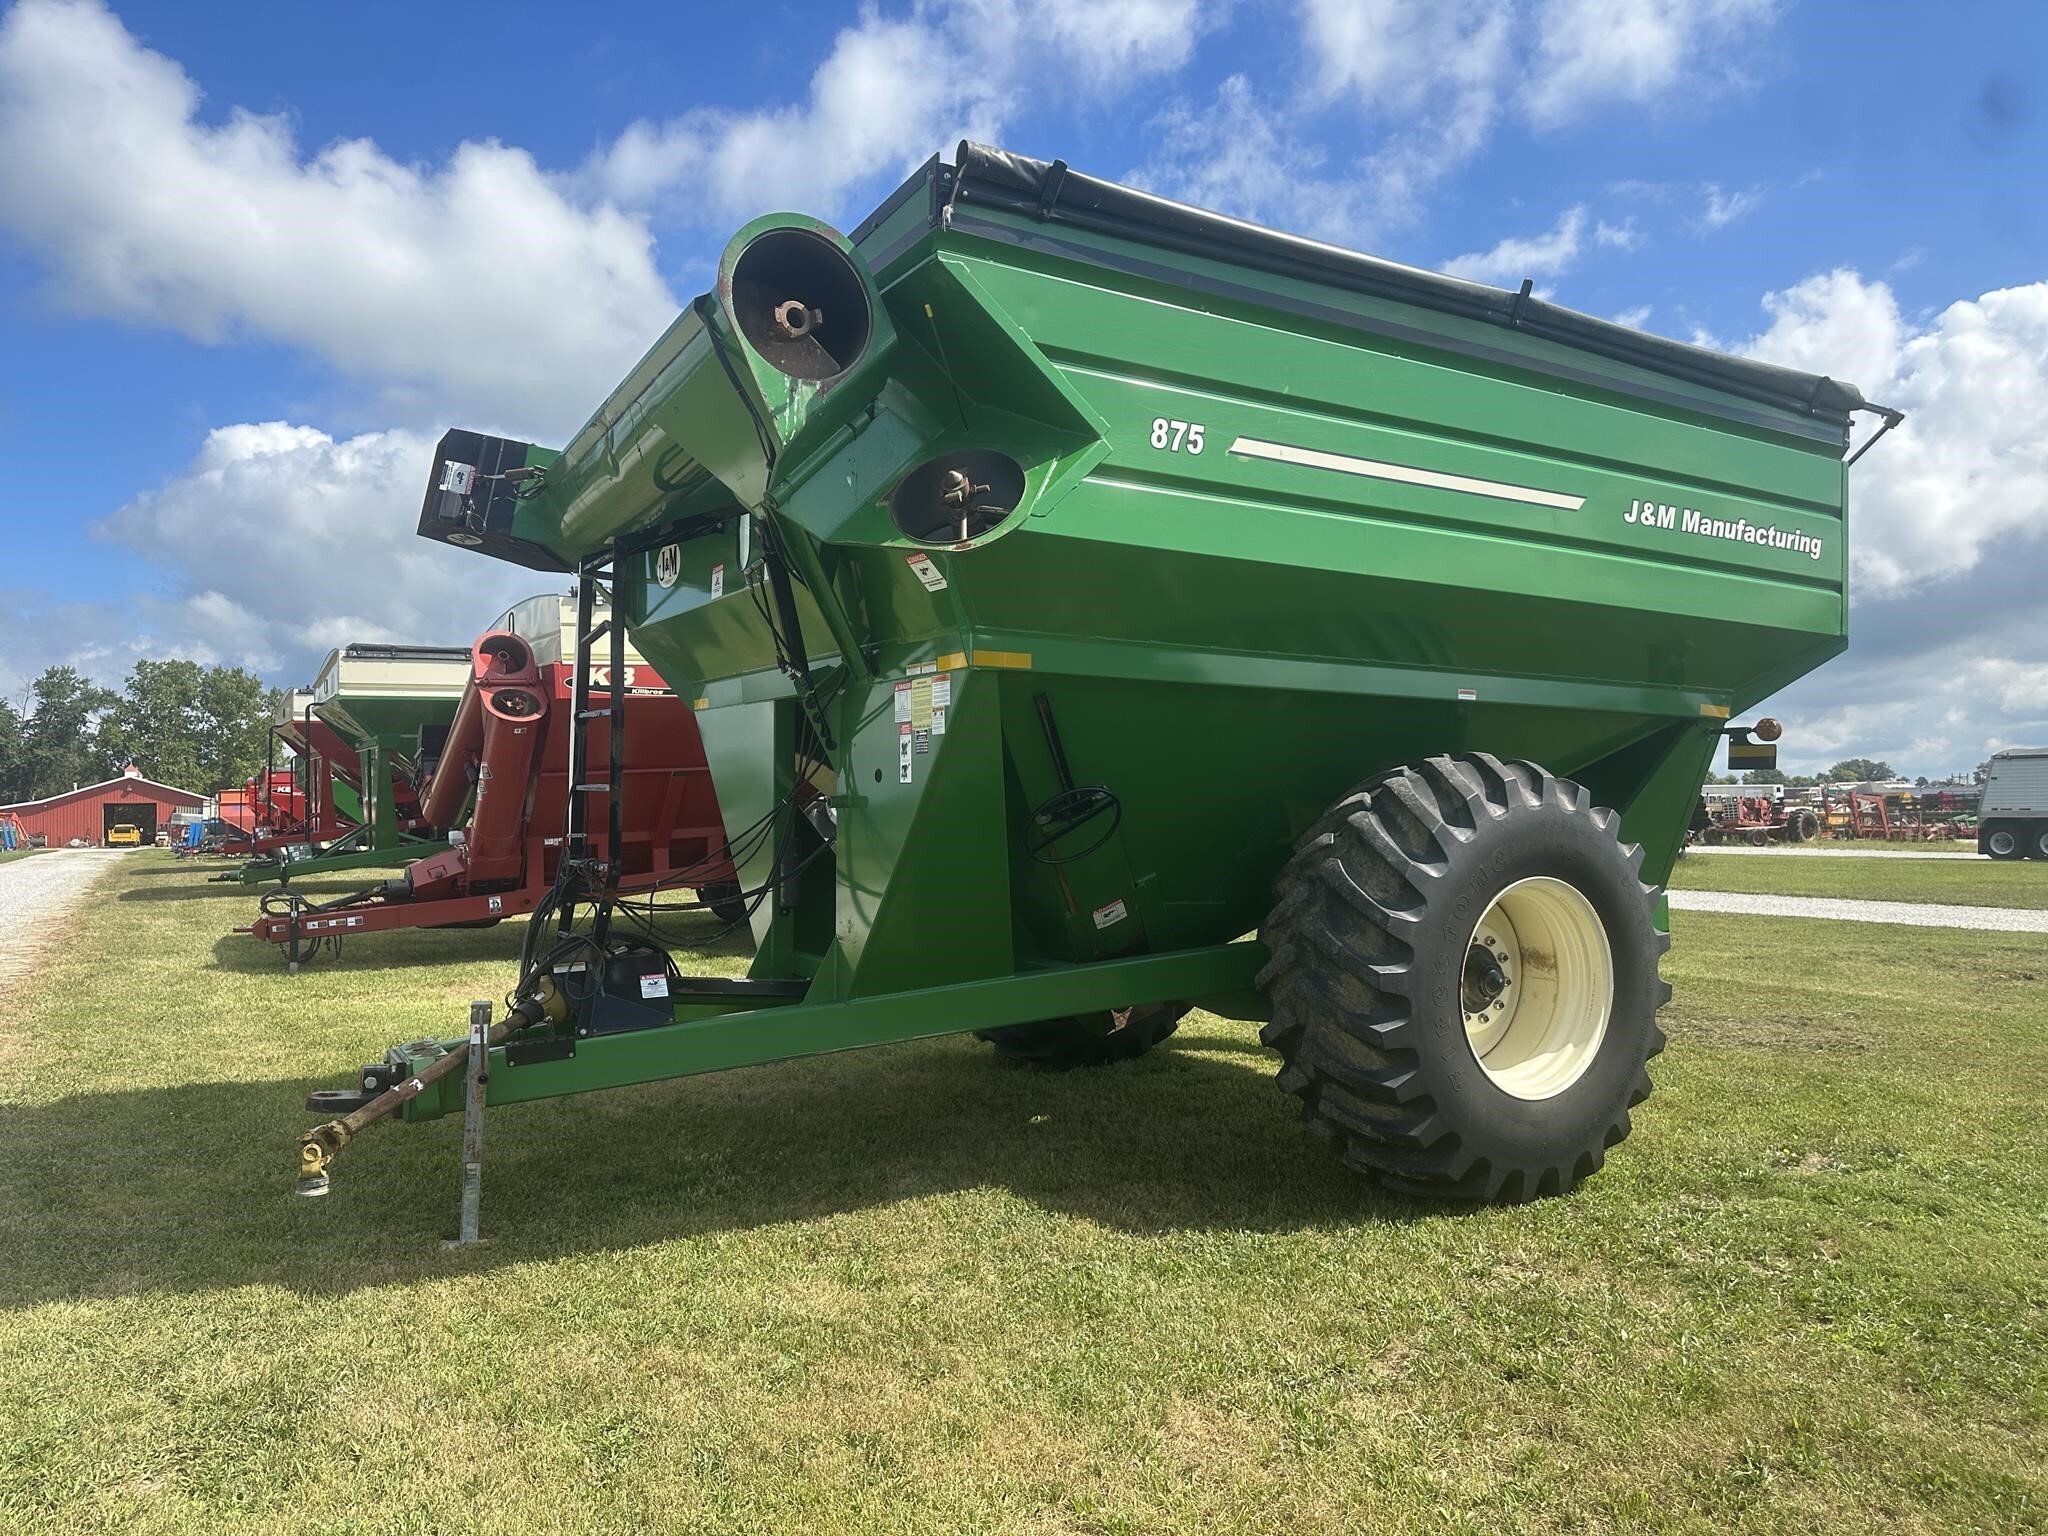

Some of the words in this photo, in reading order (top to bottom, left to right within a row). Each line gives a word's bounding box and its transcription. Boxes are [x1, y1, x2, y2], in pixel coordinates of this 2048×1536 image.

[1150, 417, 1205, 456] 875
[1623, 499, 1677, 530] J&M
[1681, 507, 1823, 560] Manufacturing
[658, 545, 678, 582] J&M
